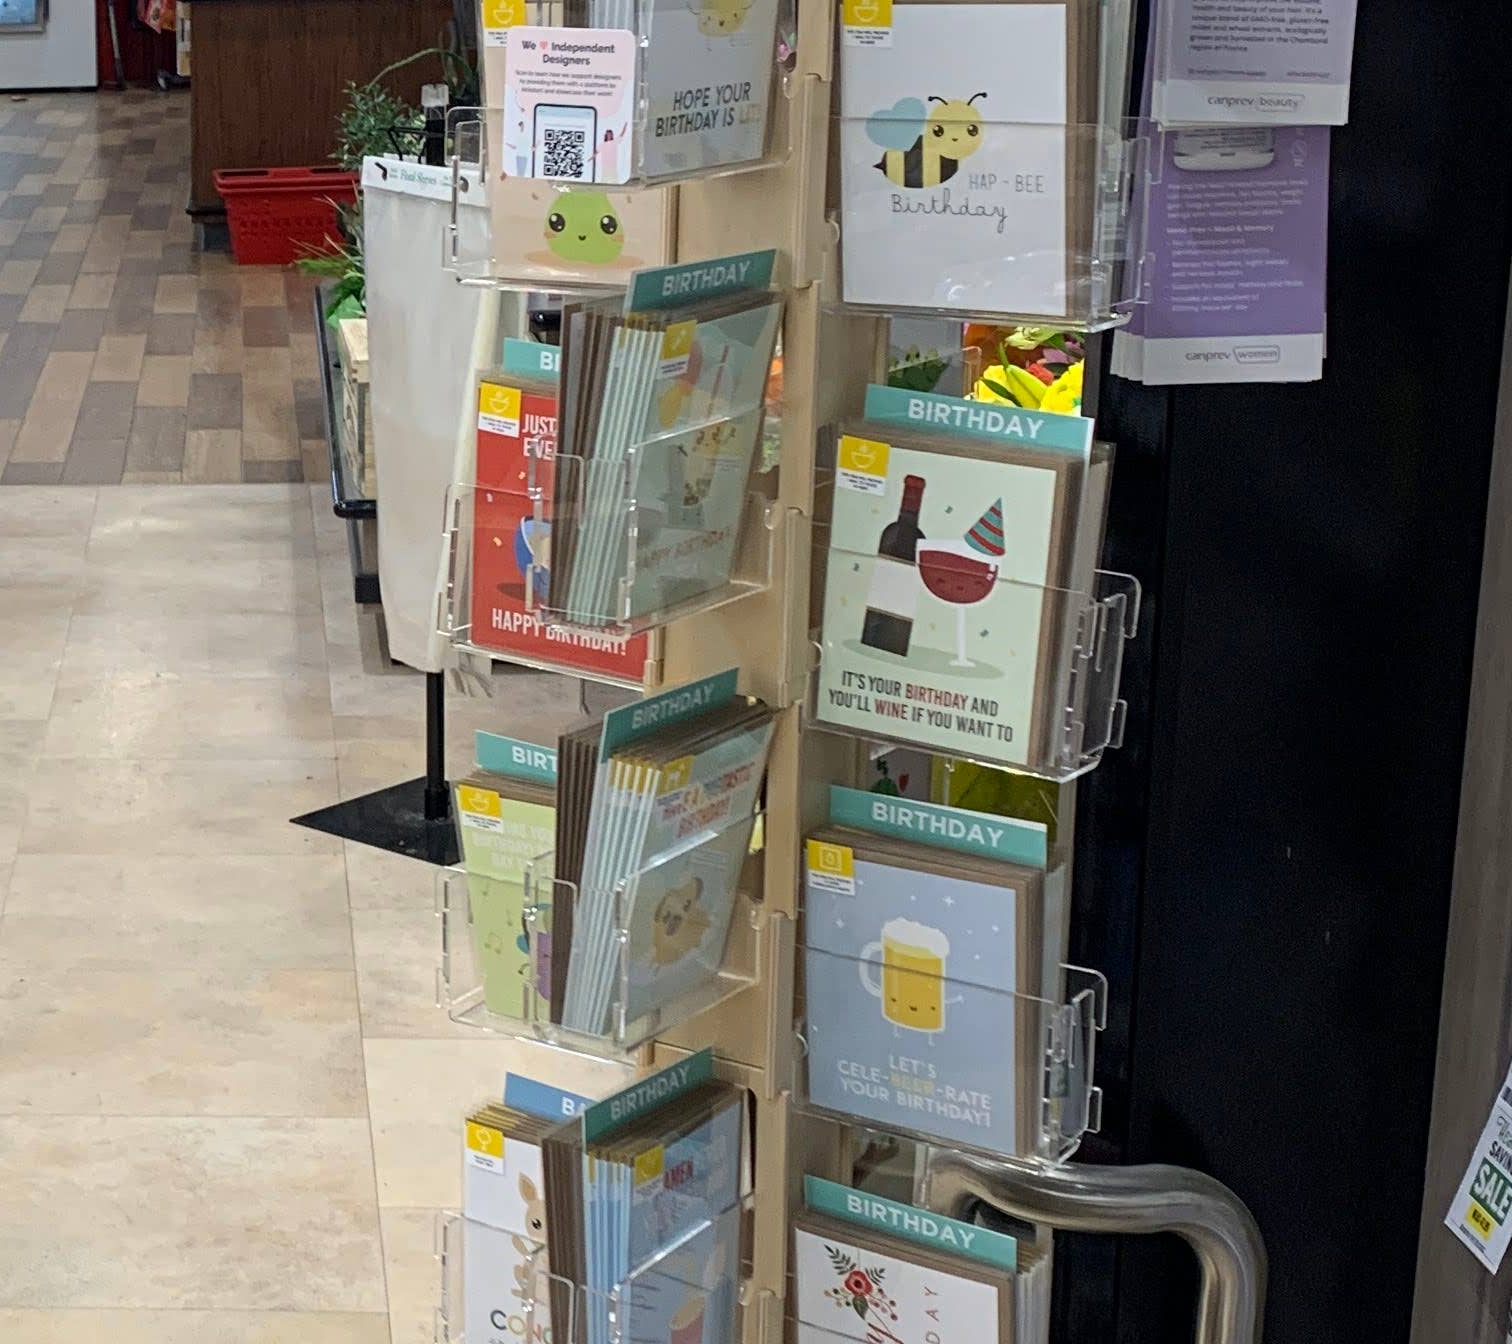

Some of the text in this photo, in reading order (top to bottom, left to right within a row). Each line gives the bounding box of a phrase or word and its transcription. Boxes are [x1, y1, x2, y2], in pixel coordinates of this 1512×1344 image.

[522, 40, 615, 54] We Independent
[542, 54, 591, 67] Designers
[673, 81, 752, 111] HOPE YOUR
[1207, 95, 1299, 109] canprev beauty
[655, 107, 736, 137] BIRTHDAY IS
[968, 174, 1045, 194] HAP BEE
[891, 188, 1008, 233] Birthday
[663, 261, 751, 296] BIRTHDAY
[1185, 350, 1278, 364] canprev women
[522, 414, 556, 436] JUST
[908, 399, 1045, 440] BIRTHDAY
[492, 607, 540, 637] HAPPY
[632, 683, 716, 729] BIRTHDAY
[841, 670, 999, 717] IT'S YOUR BIRTHDAY AND
[828, 688, 1014, 742] YOU'LL WINE IF YOU WANT TO
[871, 801, 1005, 849] BIRTHDAY
[889, 1054, 937, 1078] LET'S
[610, 1068, 689, 1120] BIRTHDAY
[839, 1076, 889, 1102] YOUR
[1473, 1163, 1512, 1221] SALE
[847, 1194, 975, 1250] BIRTHDAY
